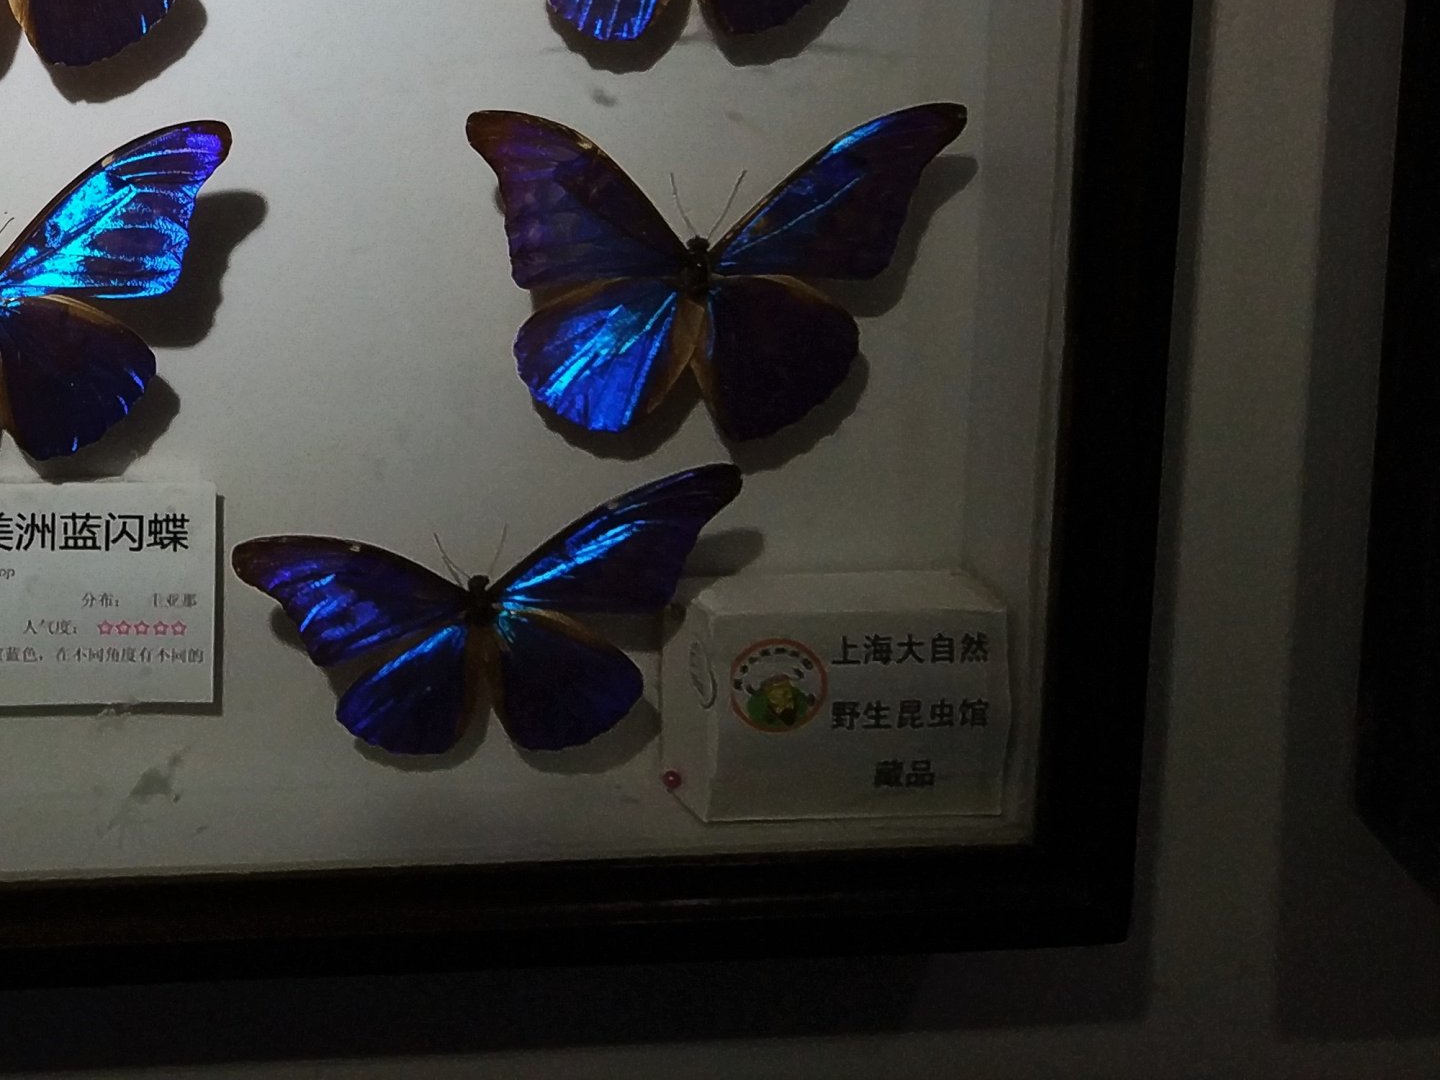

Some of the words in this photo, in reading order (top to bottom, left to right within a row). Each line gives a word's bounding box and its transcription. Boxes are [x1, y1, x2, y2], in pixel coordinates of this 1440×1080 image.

[831, 632, 989, 665] 上海大自然
[831, 698, 989, 731] 野生昆虫馆
